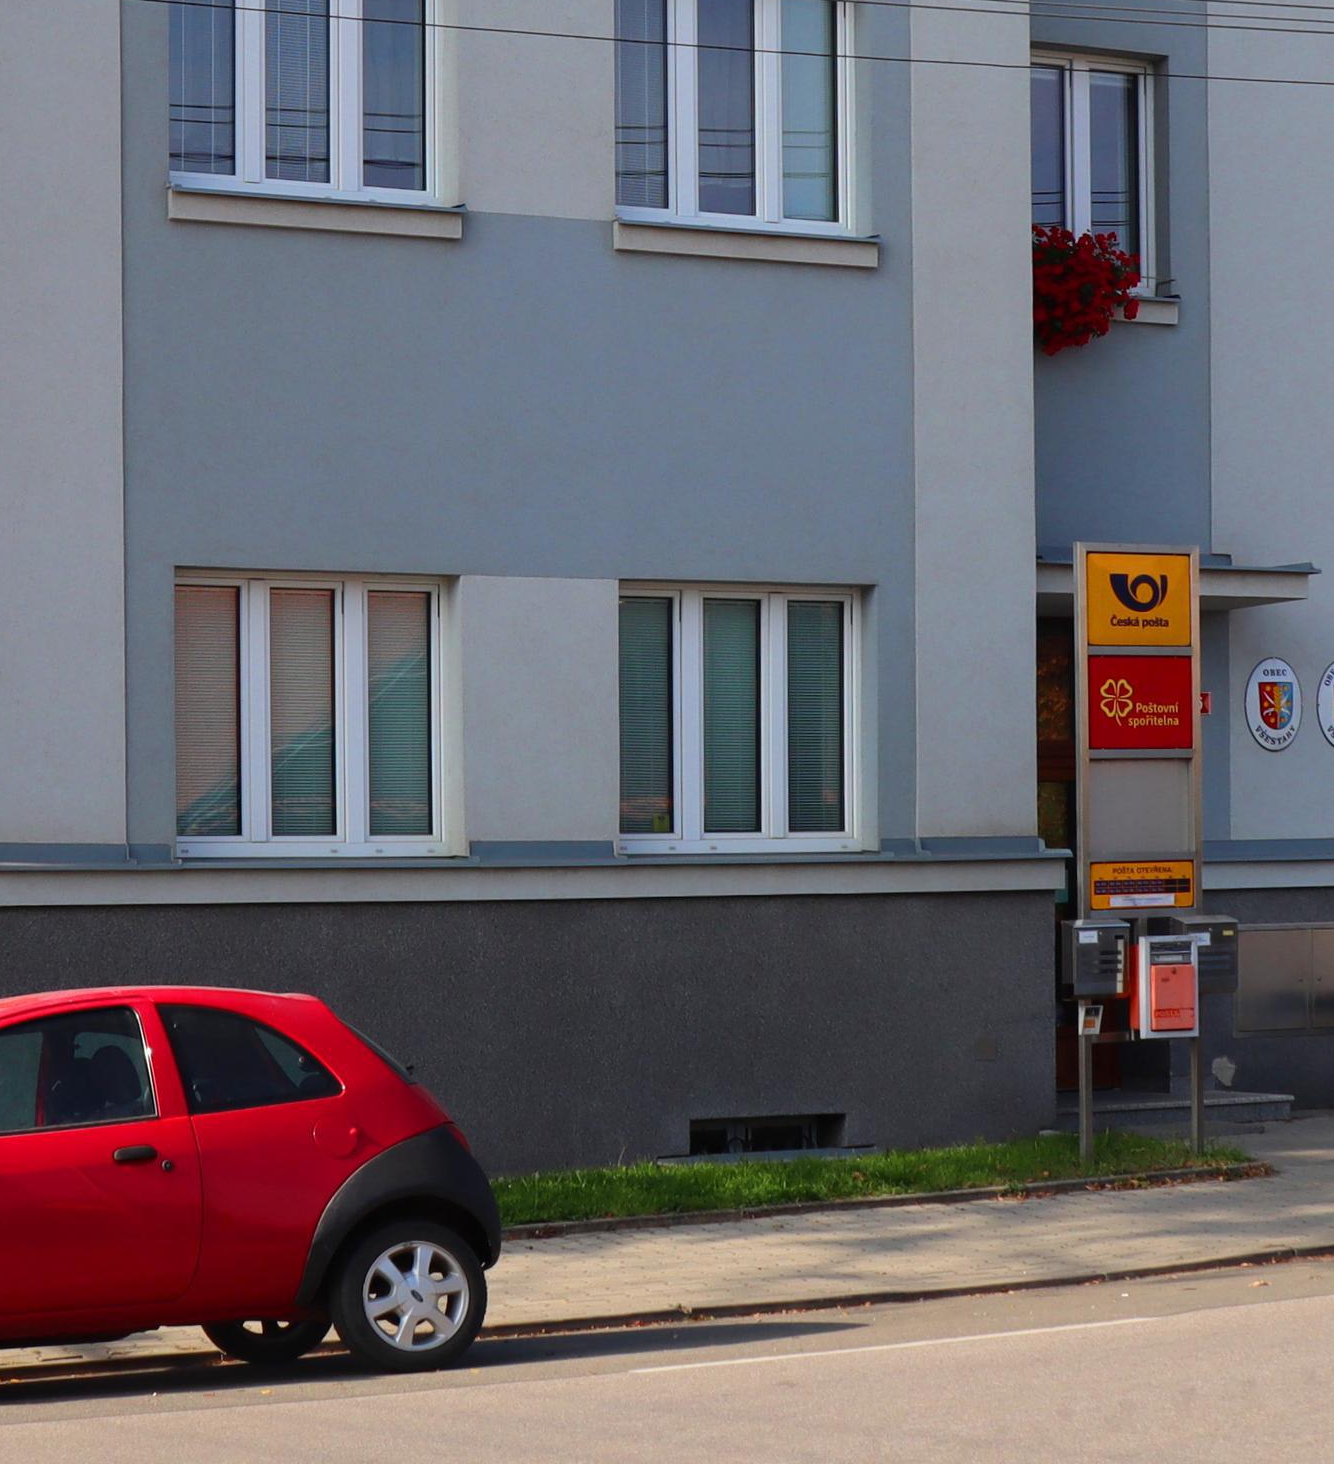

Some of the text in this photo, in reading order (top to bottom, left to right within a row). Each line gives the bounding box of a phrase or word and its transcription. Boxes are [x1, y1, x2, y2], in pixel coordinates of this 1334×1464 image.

[1110, 614, 1169, 629] Česká pošta
[1262, 668, 1287, 677] OBEC
[1135, 702, 1179, 714] Poštovní
[1128, 715, 1179, 729] spořitelna
[1255, 725, 1295, 745] VŠESTARY
